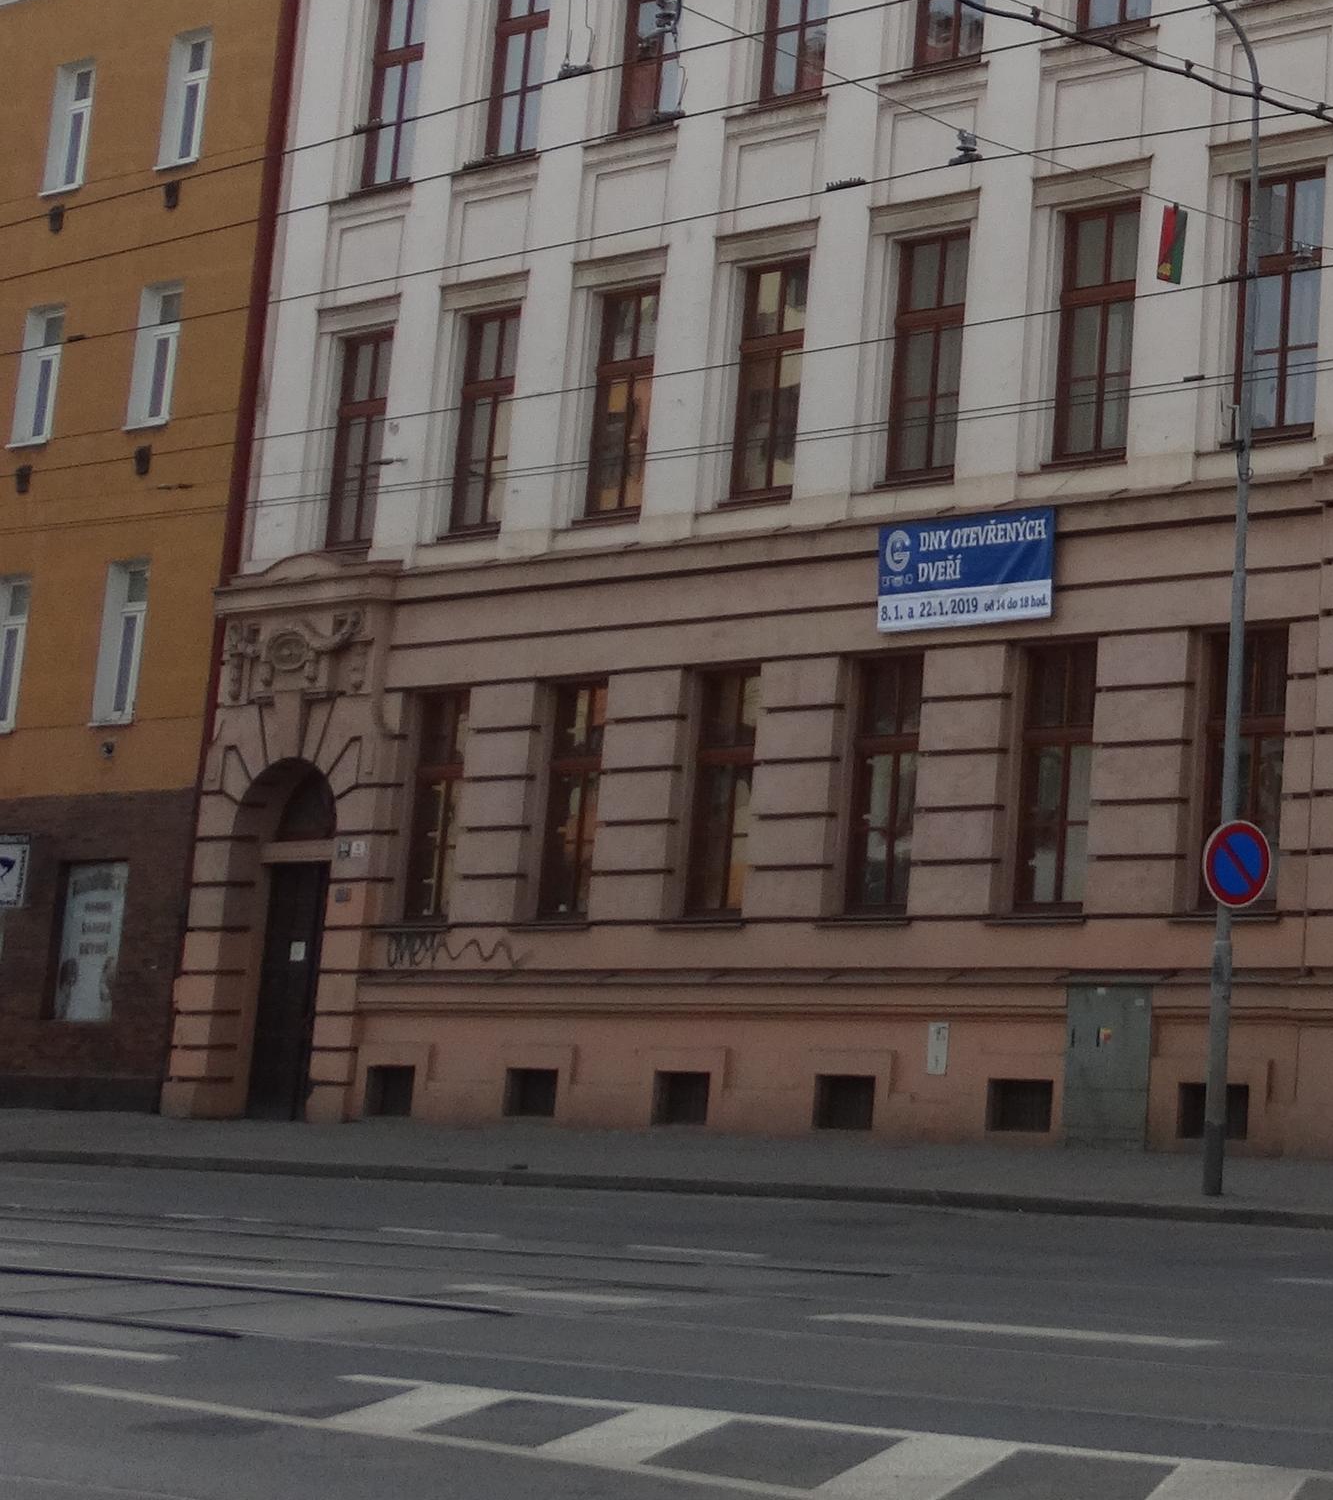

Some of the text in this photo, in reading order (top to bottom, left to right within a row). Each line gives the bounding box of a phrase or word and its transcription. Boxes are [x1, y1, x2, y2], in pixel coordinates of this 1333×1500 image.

[919, 516, 1047, 552] DNY OTEVŘENÝCH
[917, 553, 963, 583] DVEŘÍ
[907, 606, 914, 619] a
[1007, 596, 1018, 610] do
